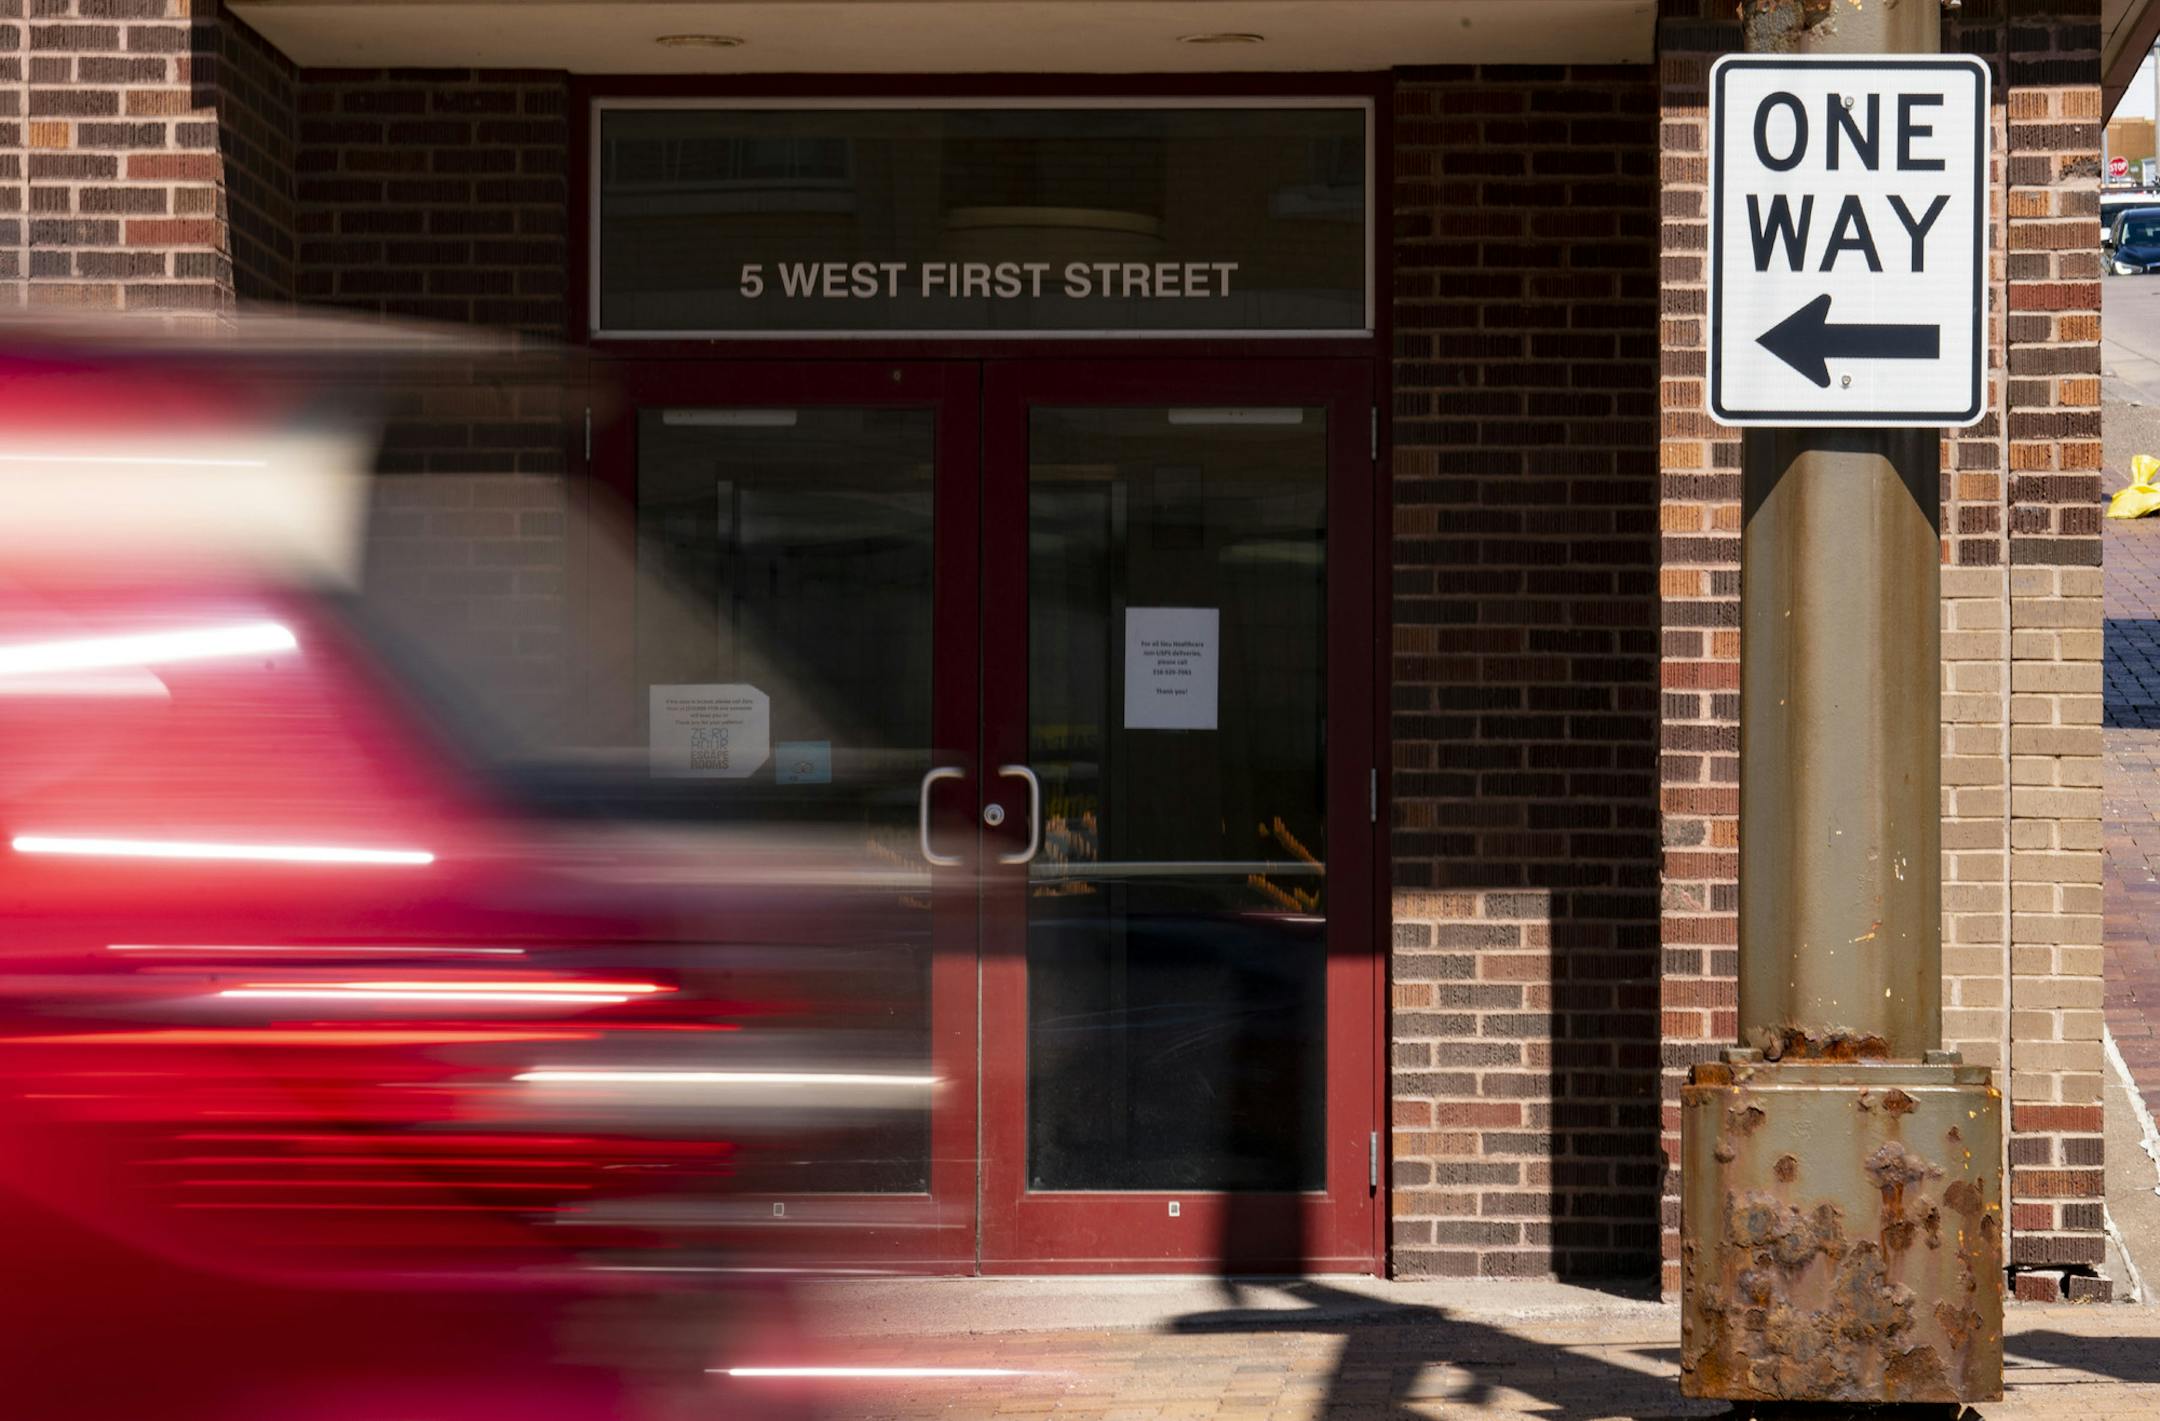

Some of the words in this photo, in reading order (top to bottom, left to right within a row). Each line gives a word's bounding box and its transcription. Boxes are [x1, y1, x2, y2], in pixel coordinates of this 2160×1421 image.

[1754, 92, 1945, 171] ONE
[2109, 161, 2128, 171] STOP
[1747, 195, 1950, 272] WAY
[741, 262, 762, 297] 5
[779, 262, 906, 297] WEST
[922, 262, 1050, 297] FIRST
[1065, 262, 1238, 297] STREET
[691, 727, 729, 740] ZERO
[691, 738, 729, 750] HOUR
[690, 750, 729, 760] ESCAPE
[690, 759, 730, 770] ROOMS
